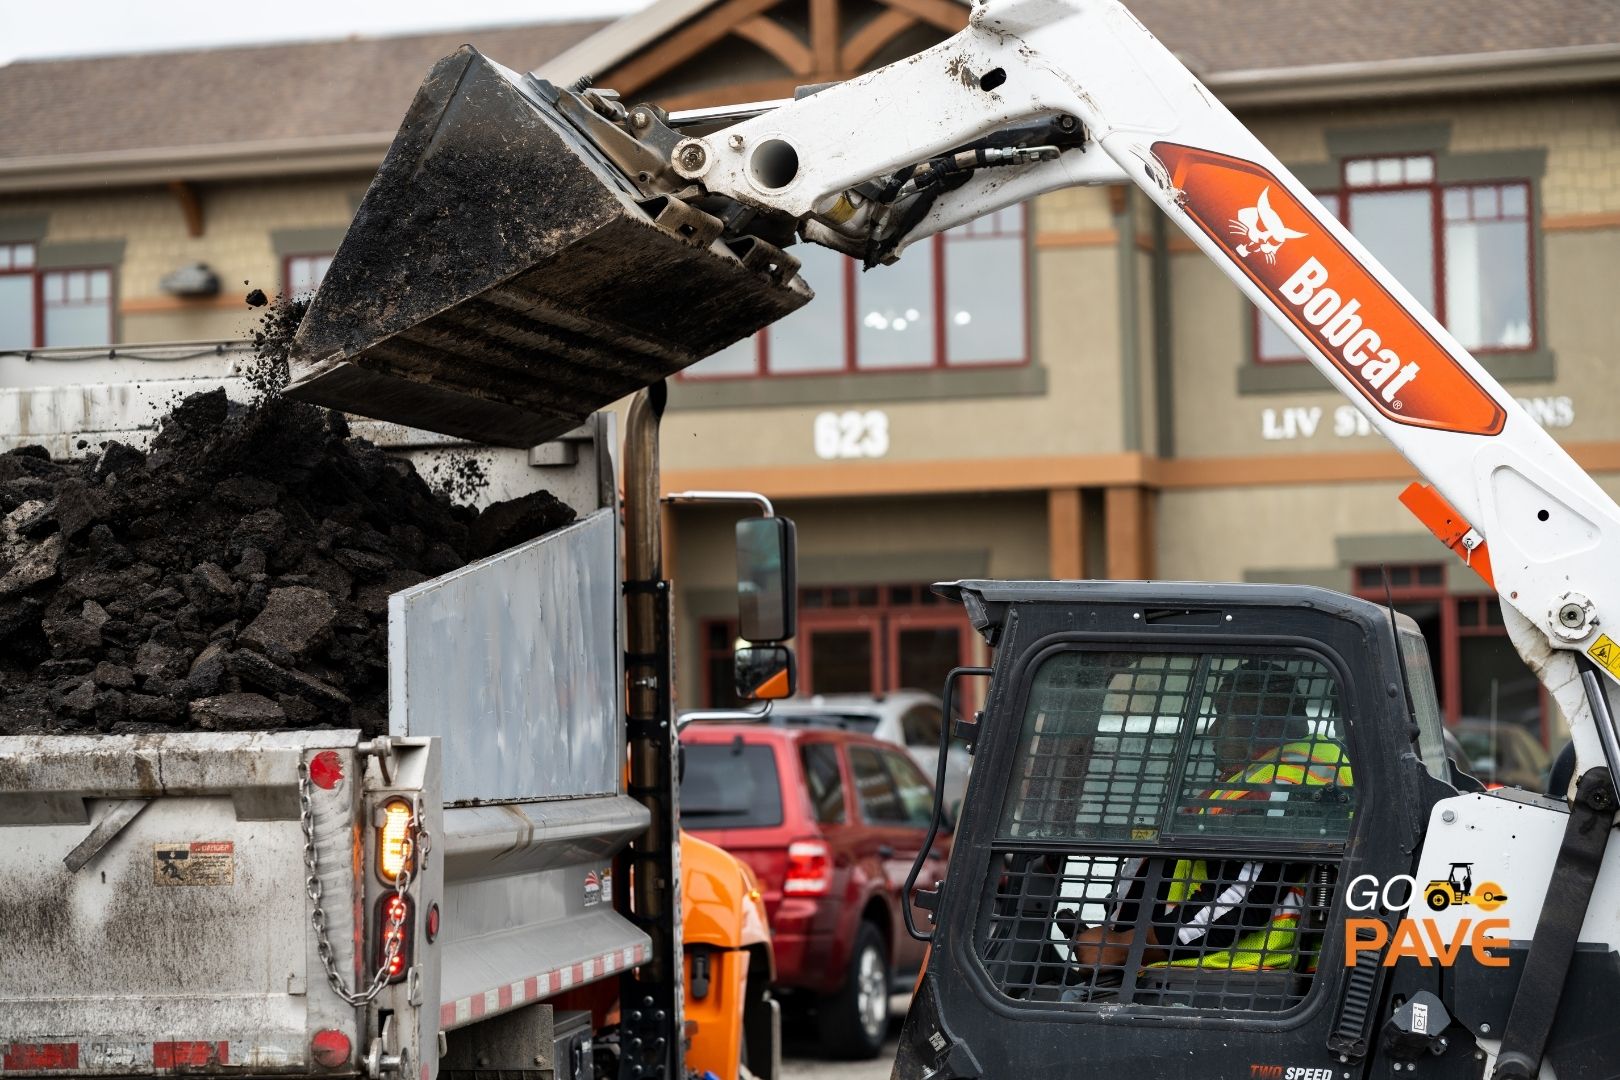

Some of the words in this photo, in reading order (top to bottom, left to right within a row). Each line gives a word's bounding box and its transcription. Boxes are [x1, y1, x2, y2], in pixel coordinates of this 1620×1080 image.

[1279, 256, 1421, 403] Bobcat
[814, 409, 889, 459] 623
[1261, 406, 1322, 439] LIV
[1250, 1064, 1283, 1078] TWO
[1285, 1067, 1332, 1080] SPEED
